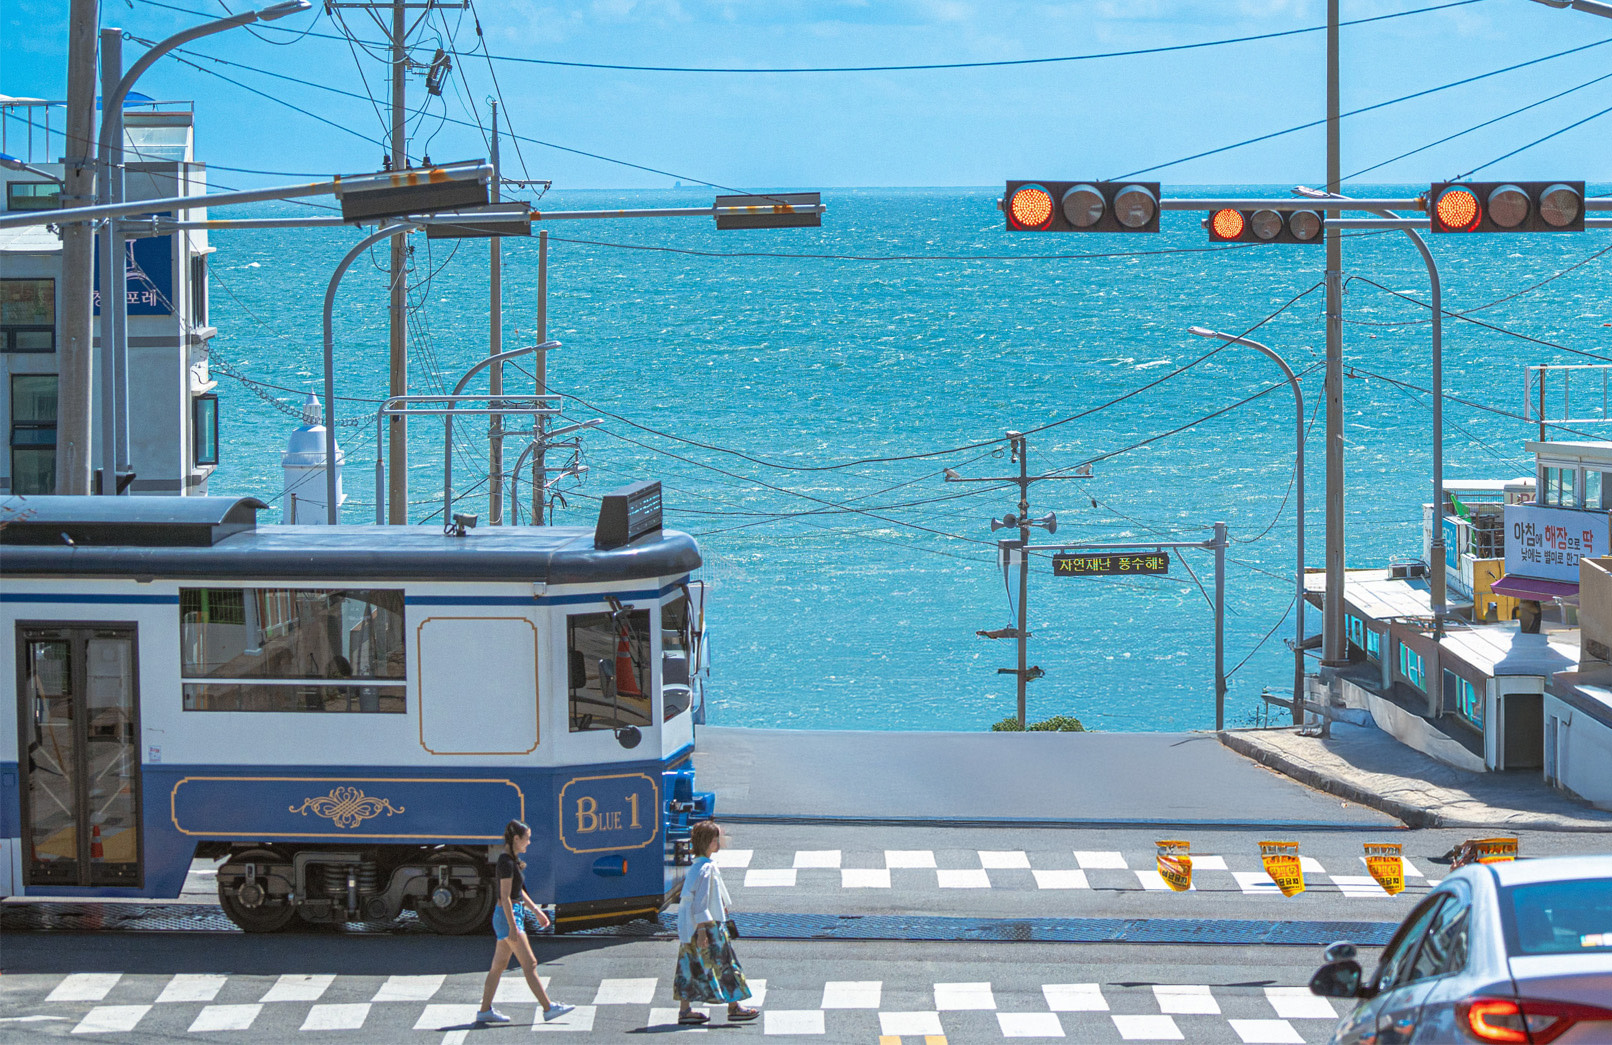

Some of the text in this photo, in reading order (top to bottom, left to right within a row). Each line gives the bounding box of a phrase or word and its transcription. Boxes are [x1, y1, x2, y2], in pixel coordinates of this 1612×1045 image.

[1514, 521, 1594, 553] 아침에 해장으로 딱
[1059, 557, 1111, 572] 자연재난
[1544, 550, 1564, 566] 별미로
[625, 793, 642, 829] 1
